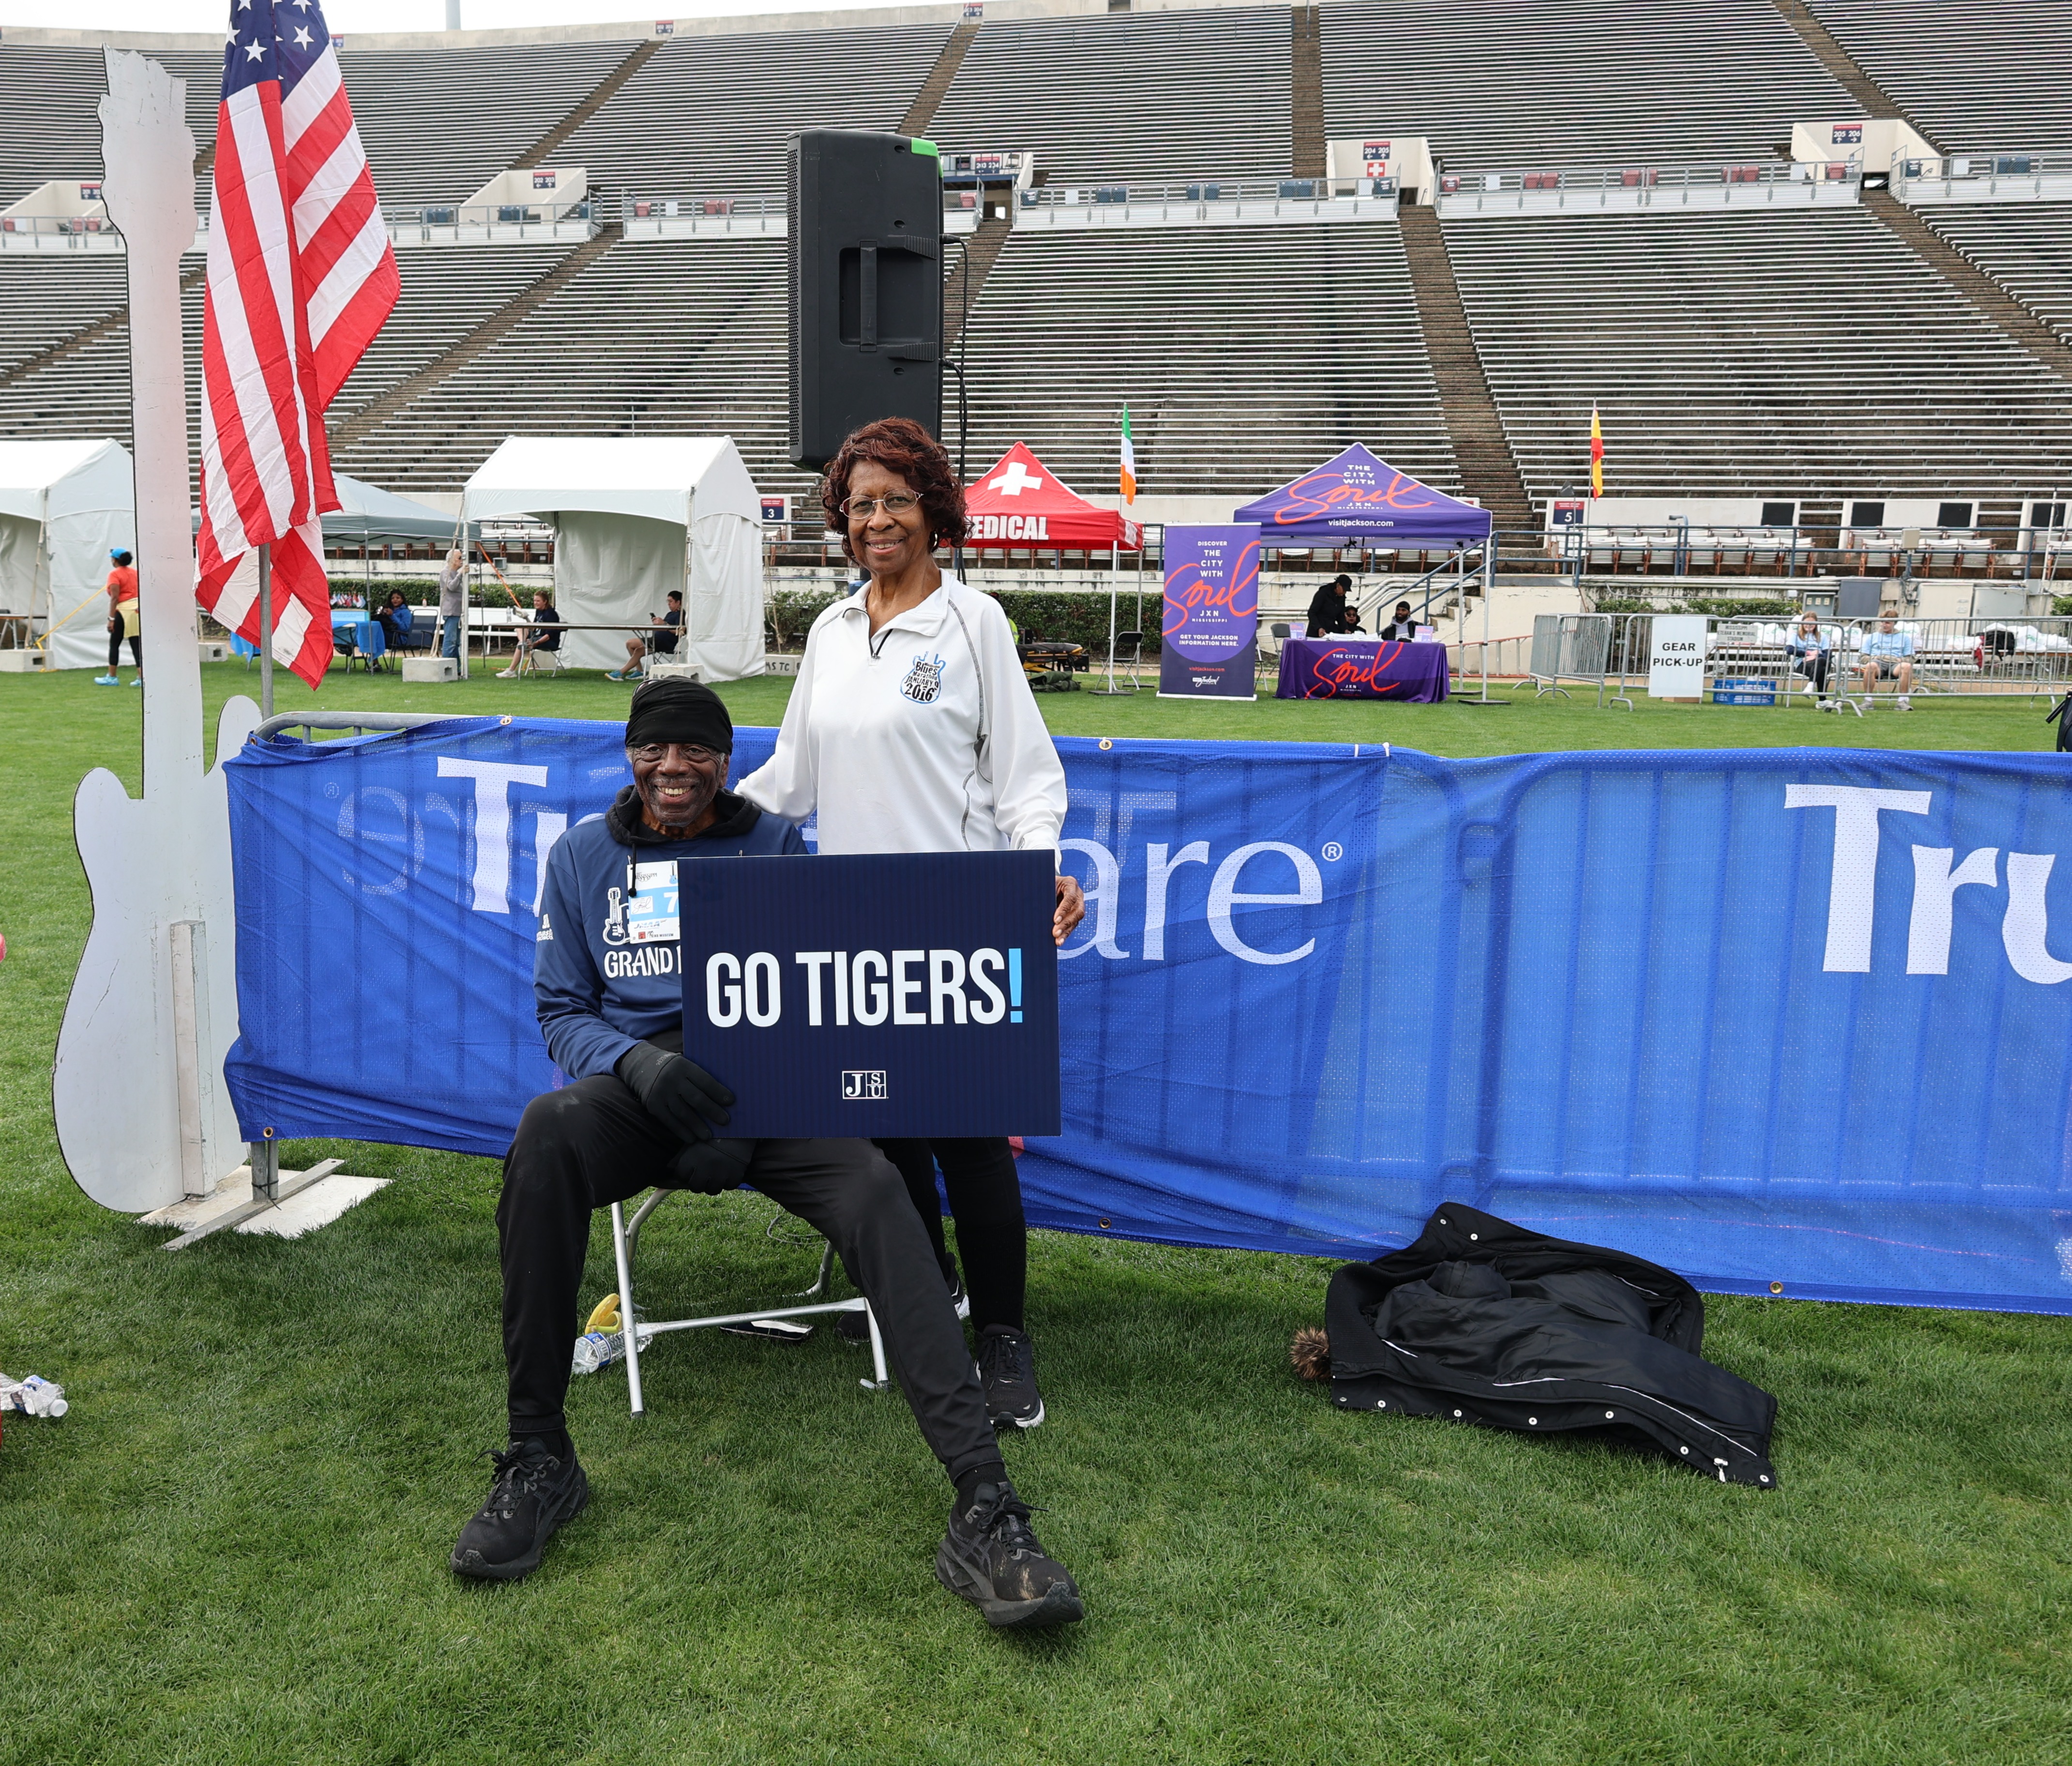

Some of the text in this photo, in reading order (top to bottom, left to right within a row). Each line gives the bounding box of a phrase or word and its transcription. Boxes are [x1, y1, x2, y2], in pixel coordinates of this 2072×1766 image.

[1274, 473, 1437, 525] Soul
[768, 508, 774, 518] 3
[1564, 512, 1572, 522] 5
[965, 515, 1049, 540] EDICAL
[1162, 540, 1261, 636] Soul
[1662, 643, 1695, 651] GEAR
[779, 662, 790, 671] TC
[916, 661, 938, 675] Blues
[1653, 658, 1703, 666] PICK-UP
[912, 671, 938, 681] Marathon
[1304, 642, 1404, 700] Soul
[904, 676, 934, 687] JANUARY
[904, 683, 935, 701] 2016
[604, 946, 673, 978] GRAND
[706, 947, 1023, 1027] GO TIGERS!
